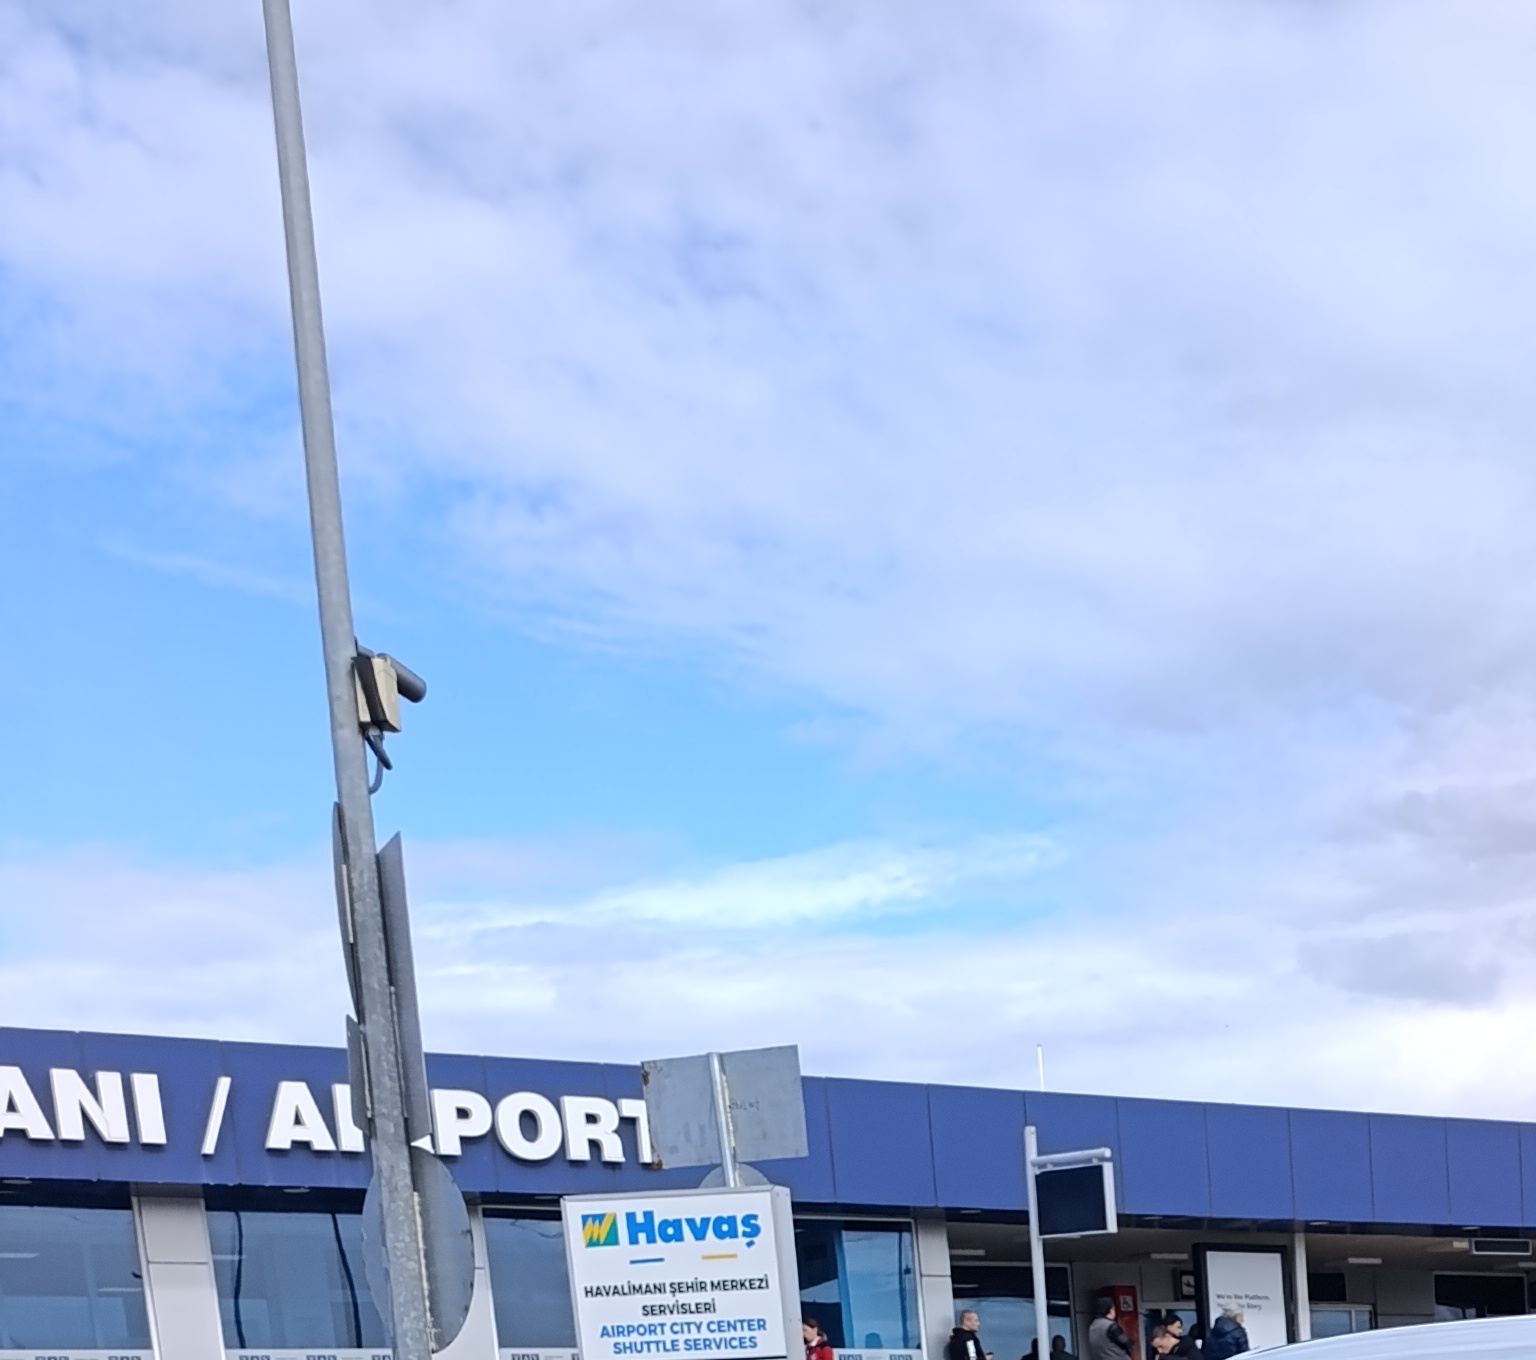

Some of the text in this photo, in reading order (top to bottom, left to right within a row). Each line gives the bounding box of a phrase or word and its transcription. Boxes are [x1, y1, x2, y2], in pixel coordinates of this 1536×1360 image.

[200, 1076, 231, 1156] /
[265, 1080, 651, 1164] AIPORT
[625, 1210, 762, 1248] Havaş
[584, 1274, 770, 1299] HAVALİMANI ŞEHİR MERKEZİ
[642, 1298, 717, 1317] SERVİSLERİ
[600, 1318, 767, 1338] AIRPORT CITY CENTER
[613, 1335, 758, 1355] SHUTTLE SERVICES
